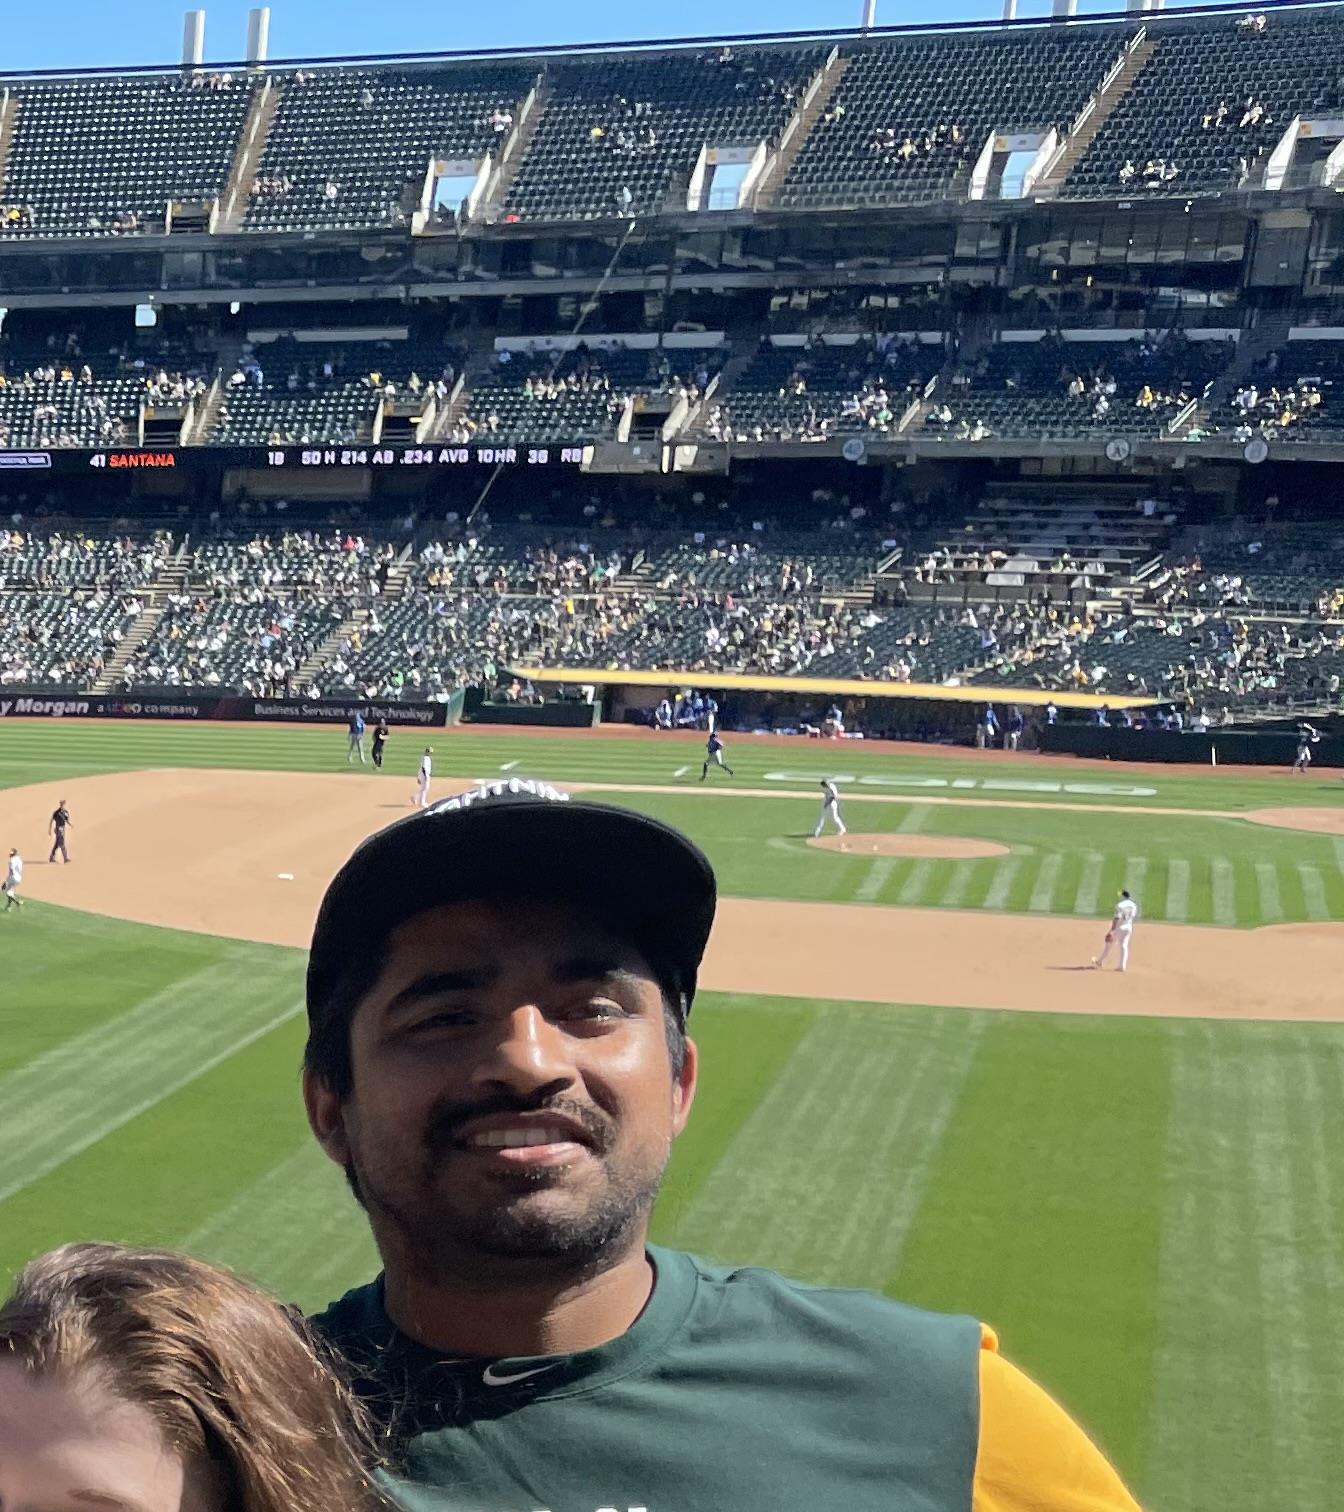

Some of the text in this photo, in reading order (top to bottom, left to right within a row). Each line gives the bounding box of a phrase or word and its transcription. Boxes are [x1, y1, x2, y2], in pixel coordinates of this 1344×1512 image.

[89, 452, 176, 468] 41 SANTANA
[15, 698, 88, 717] Morgan
[144, 704, 199, 715] company
[254, 704, 300, 716] Business
[302, 705, 345, 717] Services
[371, 705, 434, 721] Technology
